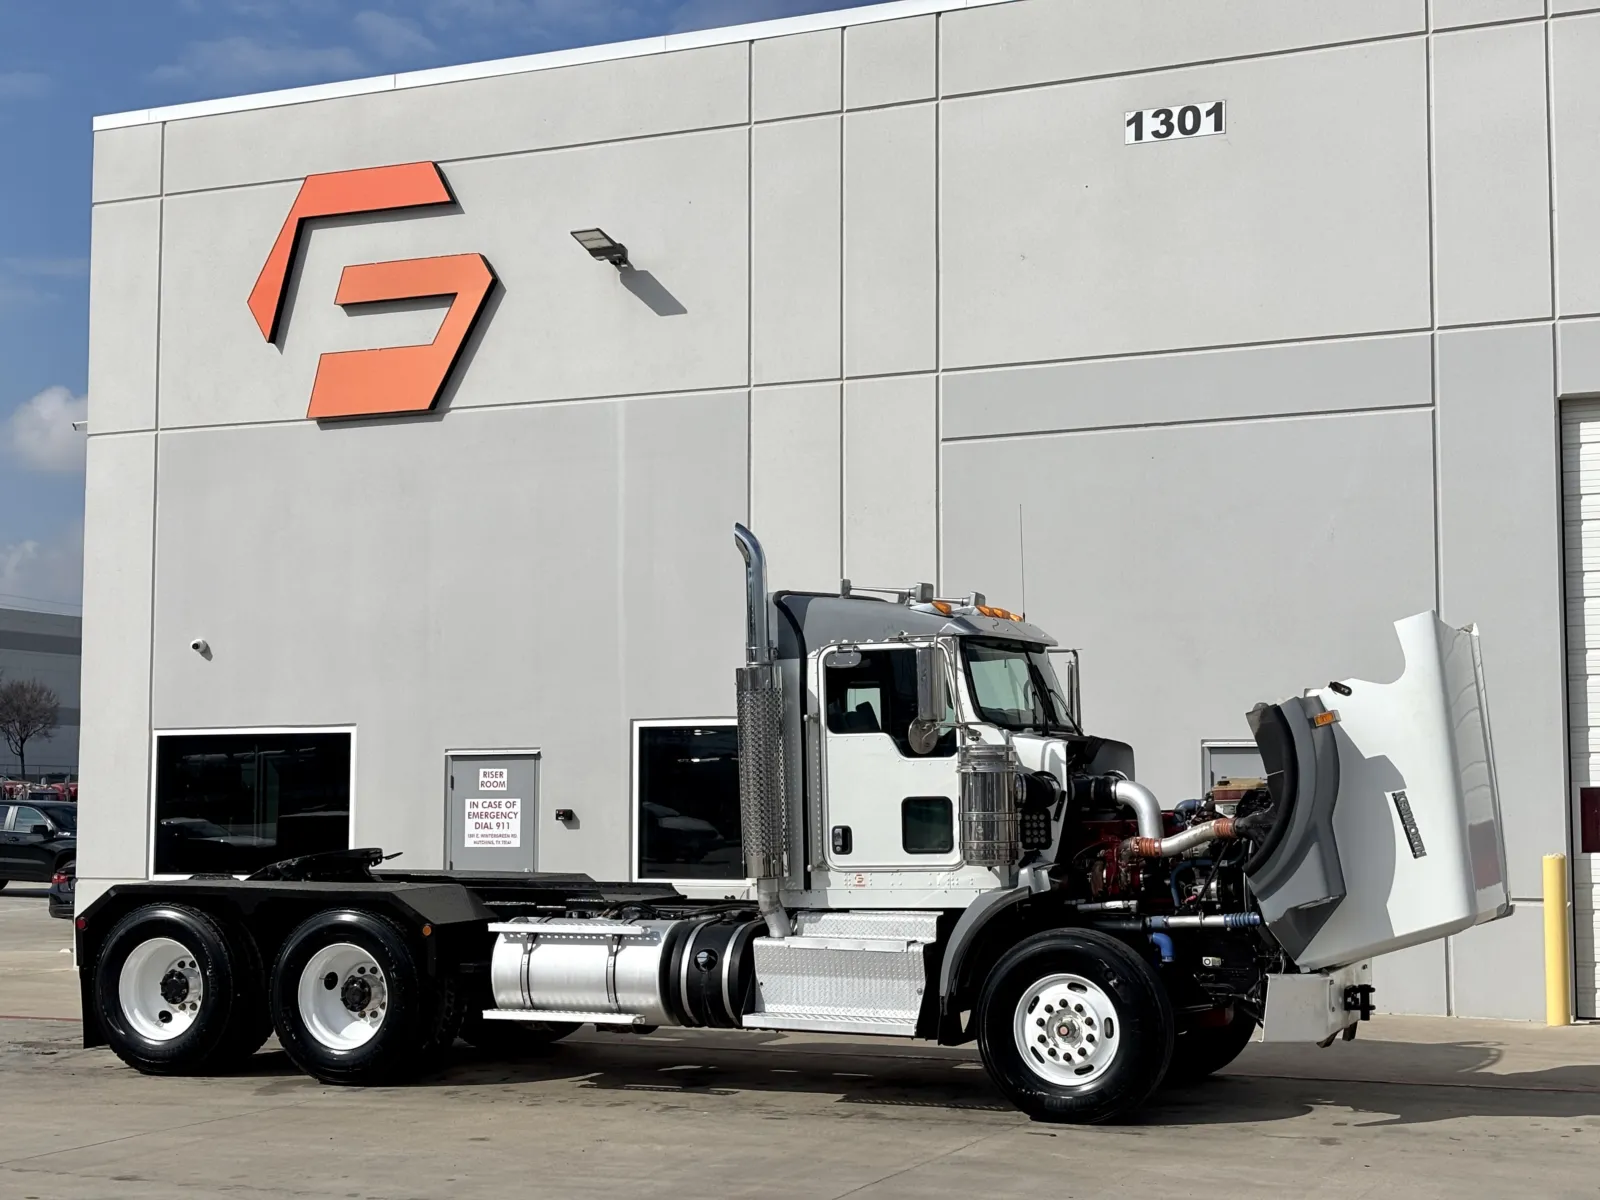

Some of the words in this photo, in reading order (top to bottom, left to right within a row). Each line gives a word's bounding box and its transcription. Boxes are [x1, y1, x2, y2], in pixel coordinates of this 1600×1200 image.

[1126, 101, 1223, 142] 1301
[482, 771, 504, 779] RISER
[480, 780, 506, 788] ROOM
[469, 801, 479, 809] IN
[481, 801, 502, 809] CASE
[504, 801, 517, 809] OF
[467, 811, 518, 820] EMERGENCY
[474, 822, 493, 830] DIAL
[495, 822, 510, 830] 911
[1395, 790, 1427, 859] KENWORTH
